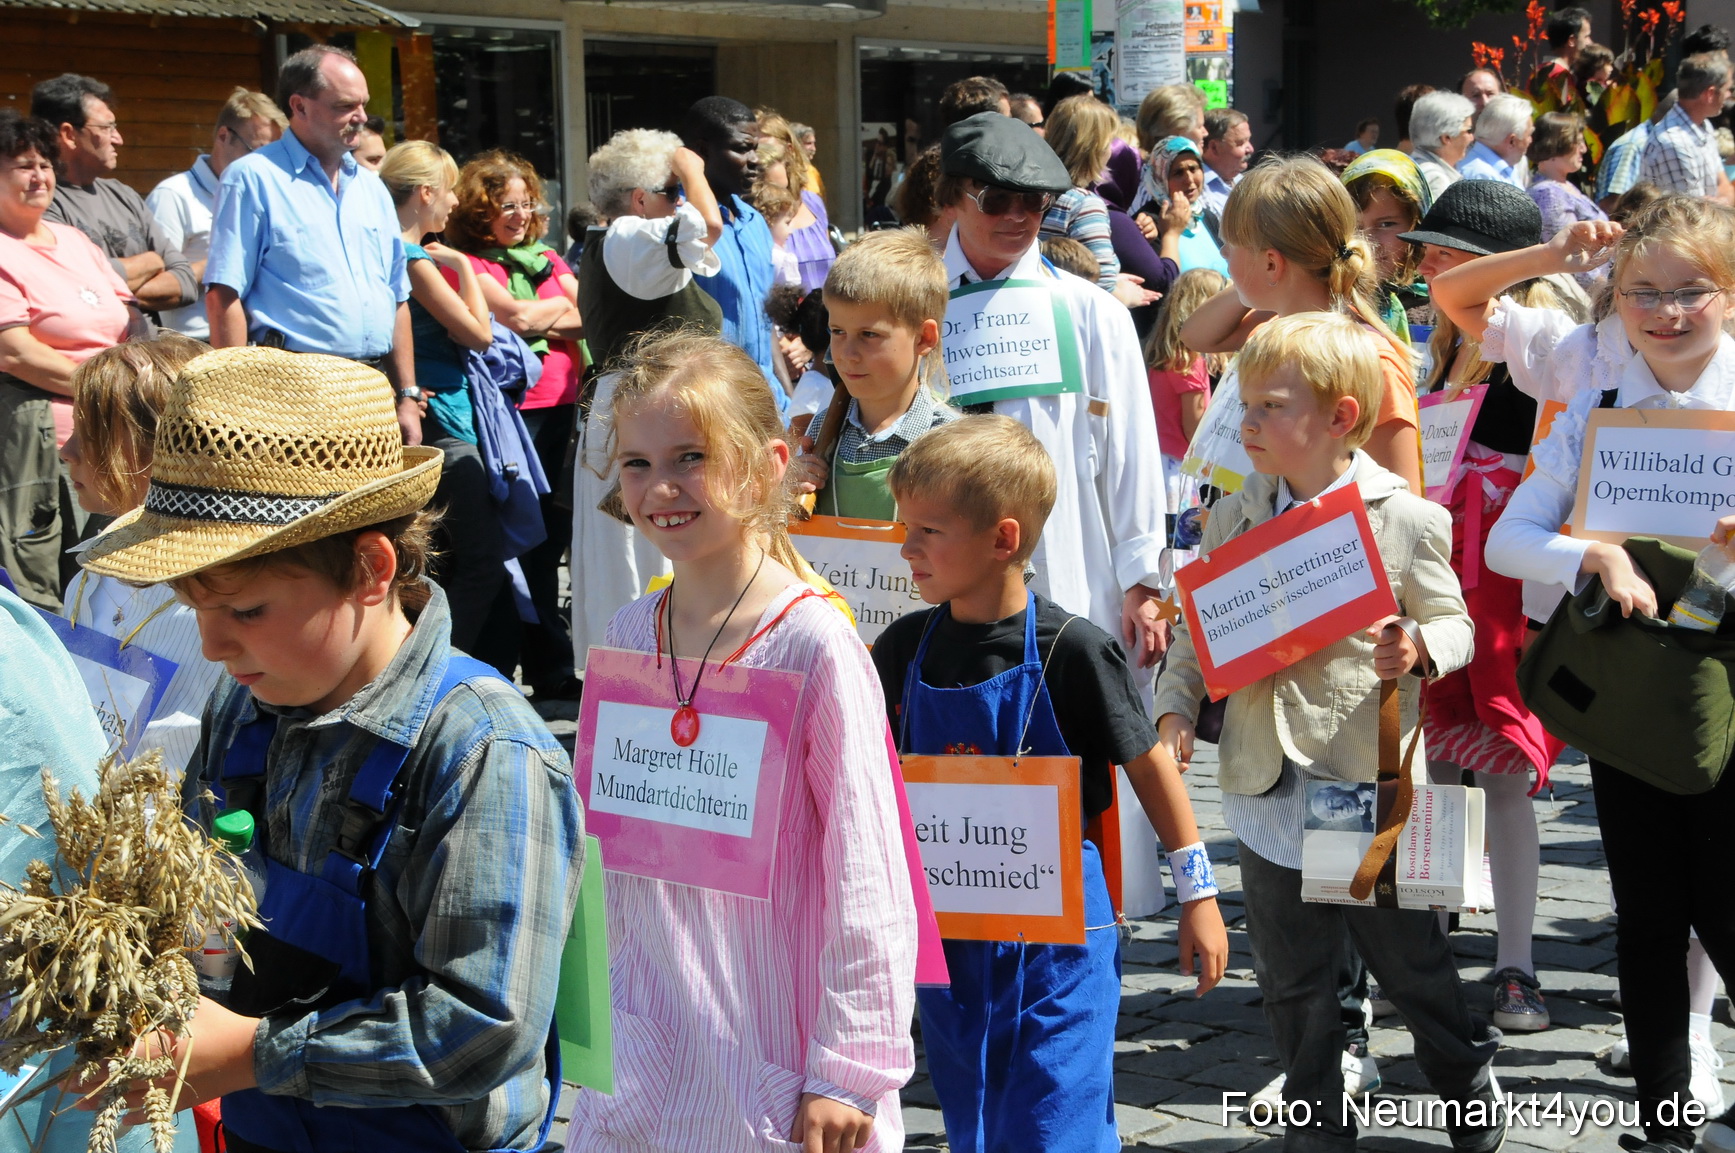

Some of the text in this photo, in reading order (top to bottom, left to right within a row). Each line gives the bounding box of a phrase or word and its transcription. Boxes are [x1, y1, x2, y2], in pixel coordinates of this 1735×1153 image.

[973, 311, 1031, 330] Franz
[942, 336, 1051, 364] hweninger
[948, 362, 1040, 386] erichtsarzt
[1425, 421, 1459, 441] Dorsch
[1598, 450, 1735, 477] Willibald G
[866, 567, 922, 601] Jung
[1200, 538, 1359, 625] Martin Schrettinger
[1207, 557, 1366, 643] Bibliothekswisschenaftler
[612, 736, 739, 779] Margret Hölle
[596, 772, 748, 821] Mundartdichterin
[911, 814, 1028, 855] eit Jung
[1407, 825, 1420, 879] Kostolanys
[1419, 788, 1433, 880] Börsenseminar
[923, 860, 1054, 890] schmied“
